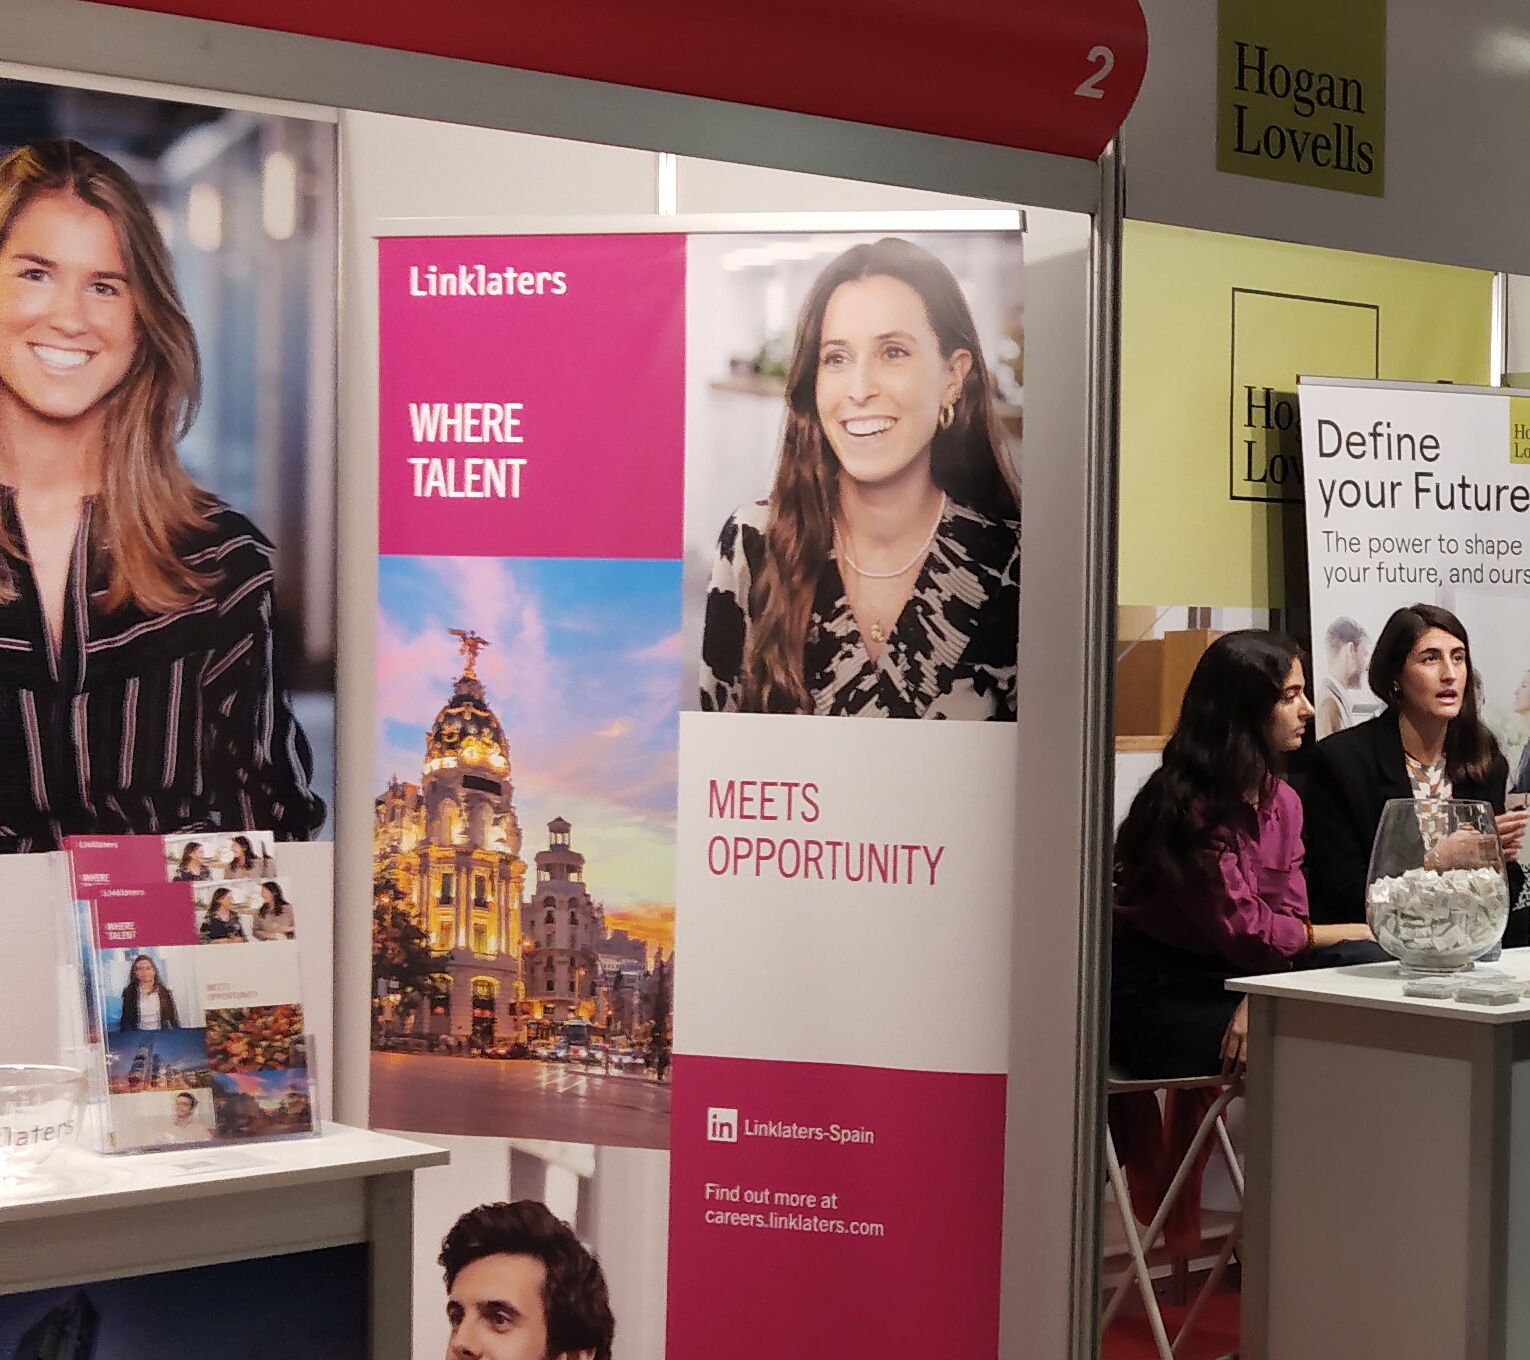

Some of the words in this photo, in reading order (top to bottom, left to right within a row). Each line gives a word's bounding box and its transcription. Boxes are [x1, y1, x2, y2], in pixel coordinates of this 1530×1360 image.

[1074, 45, 1115, 99] 2
[1233, 41, 1366, 118] Hogan
[1233, 103, 1375, 176] Lovells
[408, 264, 568, 297] Linklaters
[407, 402, 525, 443] WHERE
[1243, 384, 1301, 443] Ho
[1317, 418, 1441, 463] Define
[406, 457, 528, 499] TALENT
[1317, 478, 1403, 519] your
[1321, 530, 1361, 554] The
[1369, 537, 1432, 559] power
[1437, 533, 1459, 555] to
[1464, 533, 1523, 560] shape
[1323, 565, 1371, 589] your
[1375, 561, 1443, 587] future,
[1448, 563, 1484, 584] and
[708, 779, 820, 823] MEETS
[708, 835, 946, 886] OPPORTUNITY
[744, 1118, 876, 1145] Linklaters-Spain
[705, 1182, 740, 1202] Find
[744, 1189, 770, 1205] out
[774, 1192, 817, 1209] more
[820, 1191, 838, 1210] at
[705, 1208, 886, 1237] careers.linklaters.com
